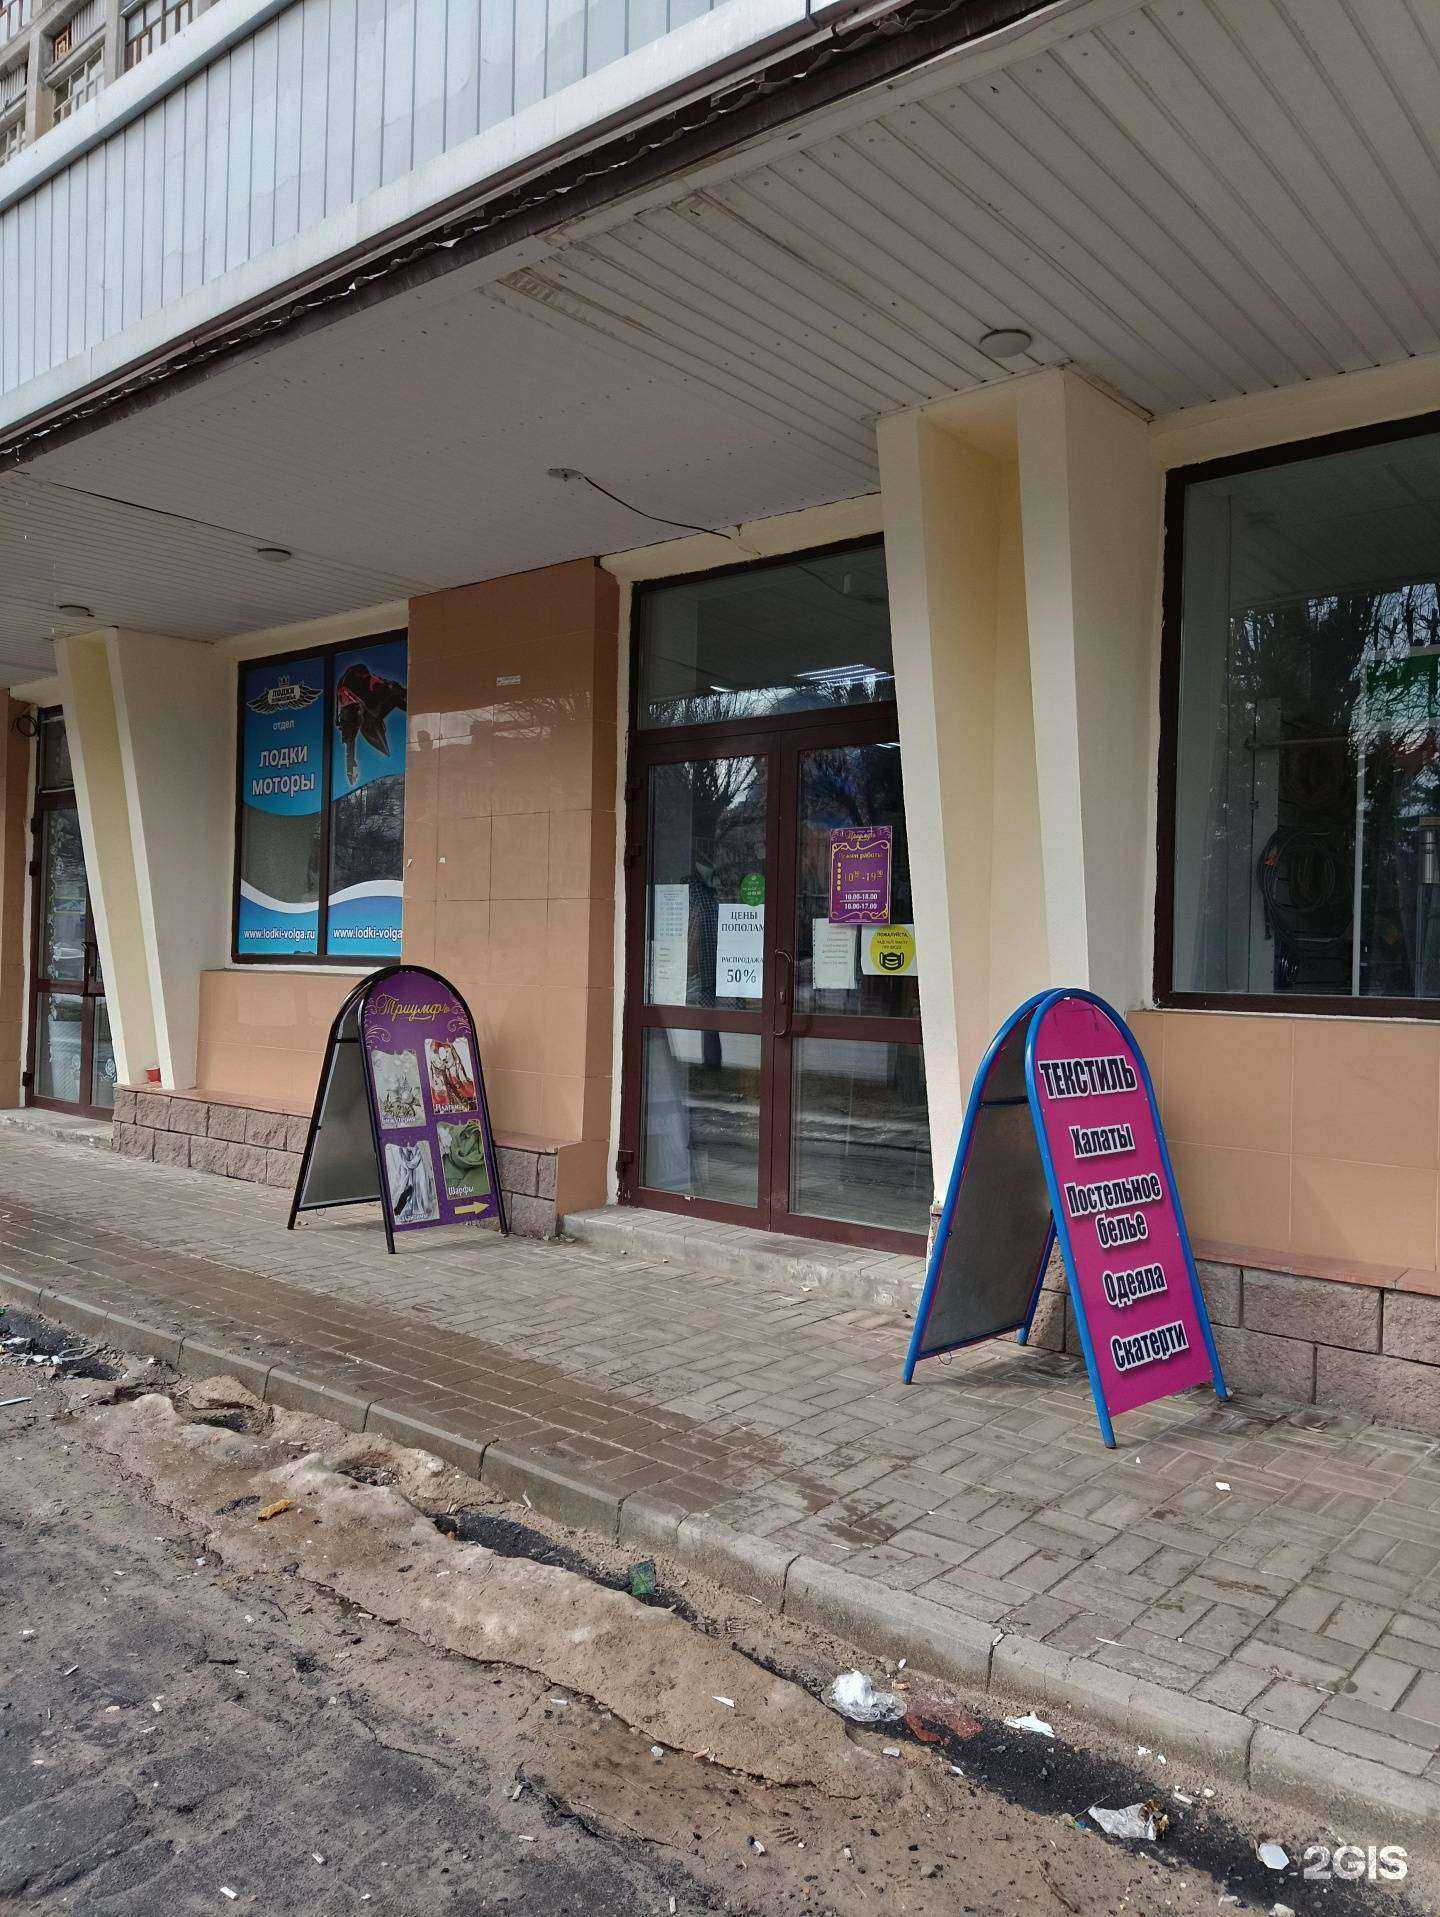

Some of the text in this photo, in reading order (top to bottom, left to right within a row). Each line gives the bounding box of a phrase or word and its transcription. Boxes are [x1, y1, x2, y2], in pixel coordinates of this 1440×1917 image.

[272, 720, 296, 731] отдел
[259, 744, 308, 769] ЛОДКИ
[252, 771, 316, 798] МОТОРЫ
[730, 911, 759, 922] ЦЕНЫ
[243, 928, 316, 942] www.lodki-volga.ru
[1039, 1055, 1137, 1099] ТЕКСТИЛЬ
[1069, 1123, 1135, 1158] Халаты
[1064, 1173, 1162, 1217] Постельное
[1096, 1211, 1148, 1248] белье
[1103, 1263, 1167, 1307] Одеяла
[1111, 1320, 1189, 1371] Скатерти
